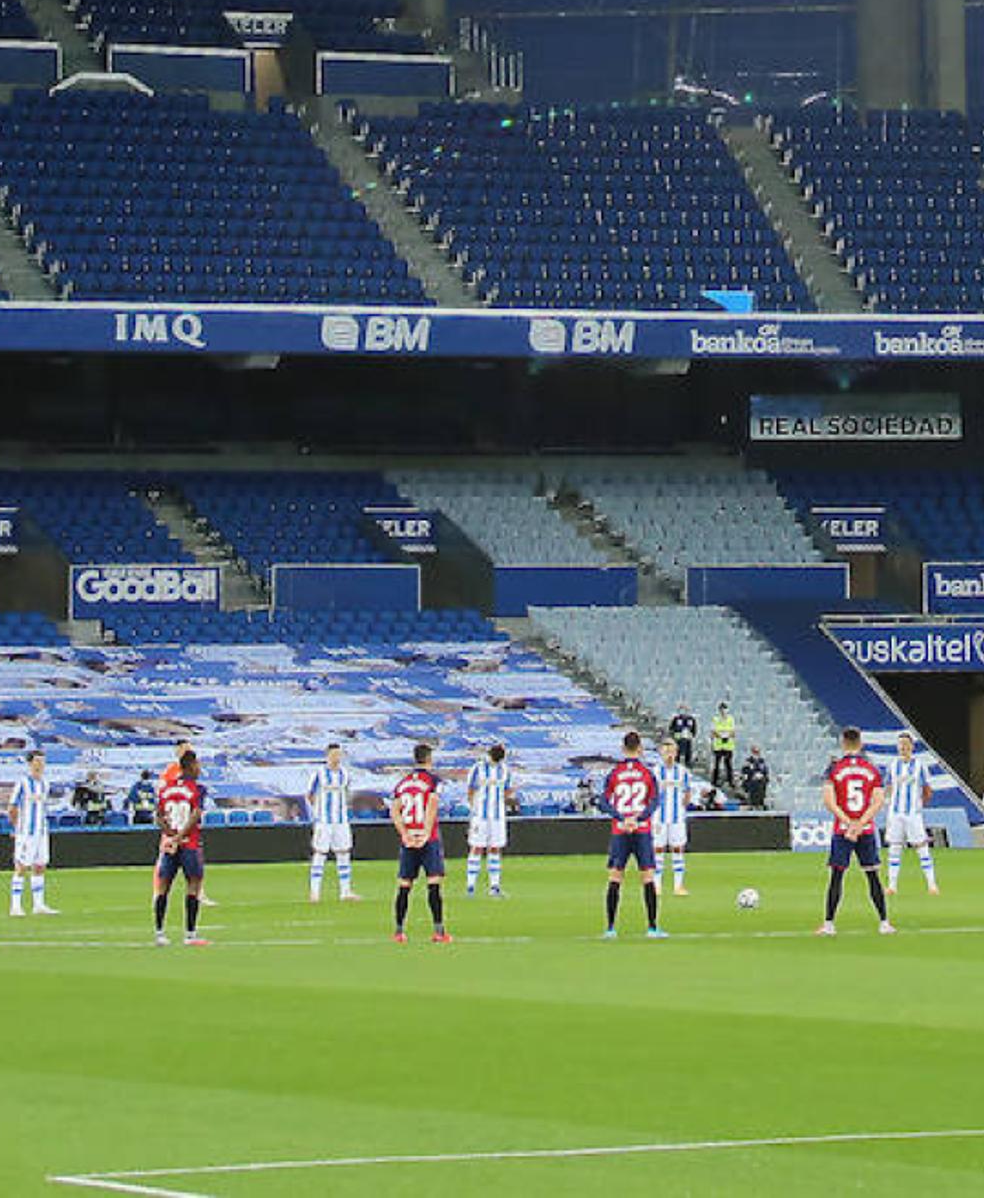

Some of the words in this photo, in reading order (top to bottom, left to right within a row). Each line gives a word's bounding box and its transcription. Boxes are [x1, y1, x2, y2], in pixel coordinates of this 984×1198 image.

[114, 313, 207, 347] IMQ
[365, 316, 431, 352] BM
[571, 319, 635, 353] BM
[759, 417, 823, 435] REAL
[828, 416, 954, 436] SOCIEDAD
[376, 519, 431, 537] ELER
[401, 793, 425, 824] 21
[614, 781, 647, 814] 22
[847, 779, 864, 812] 5
